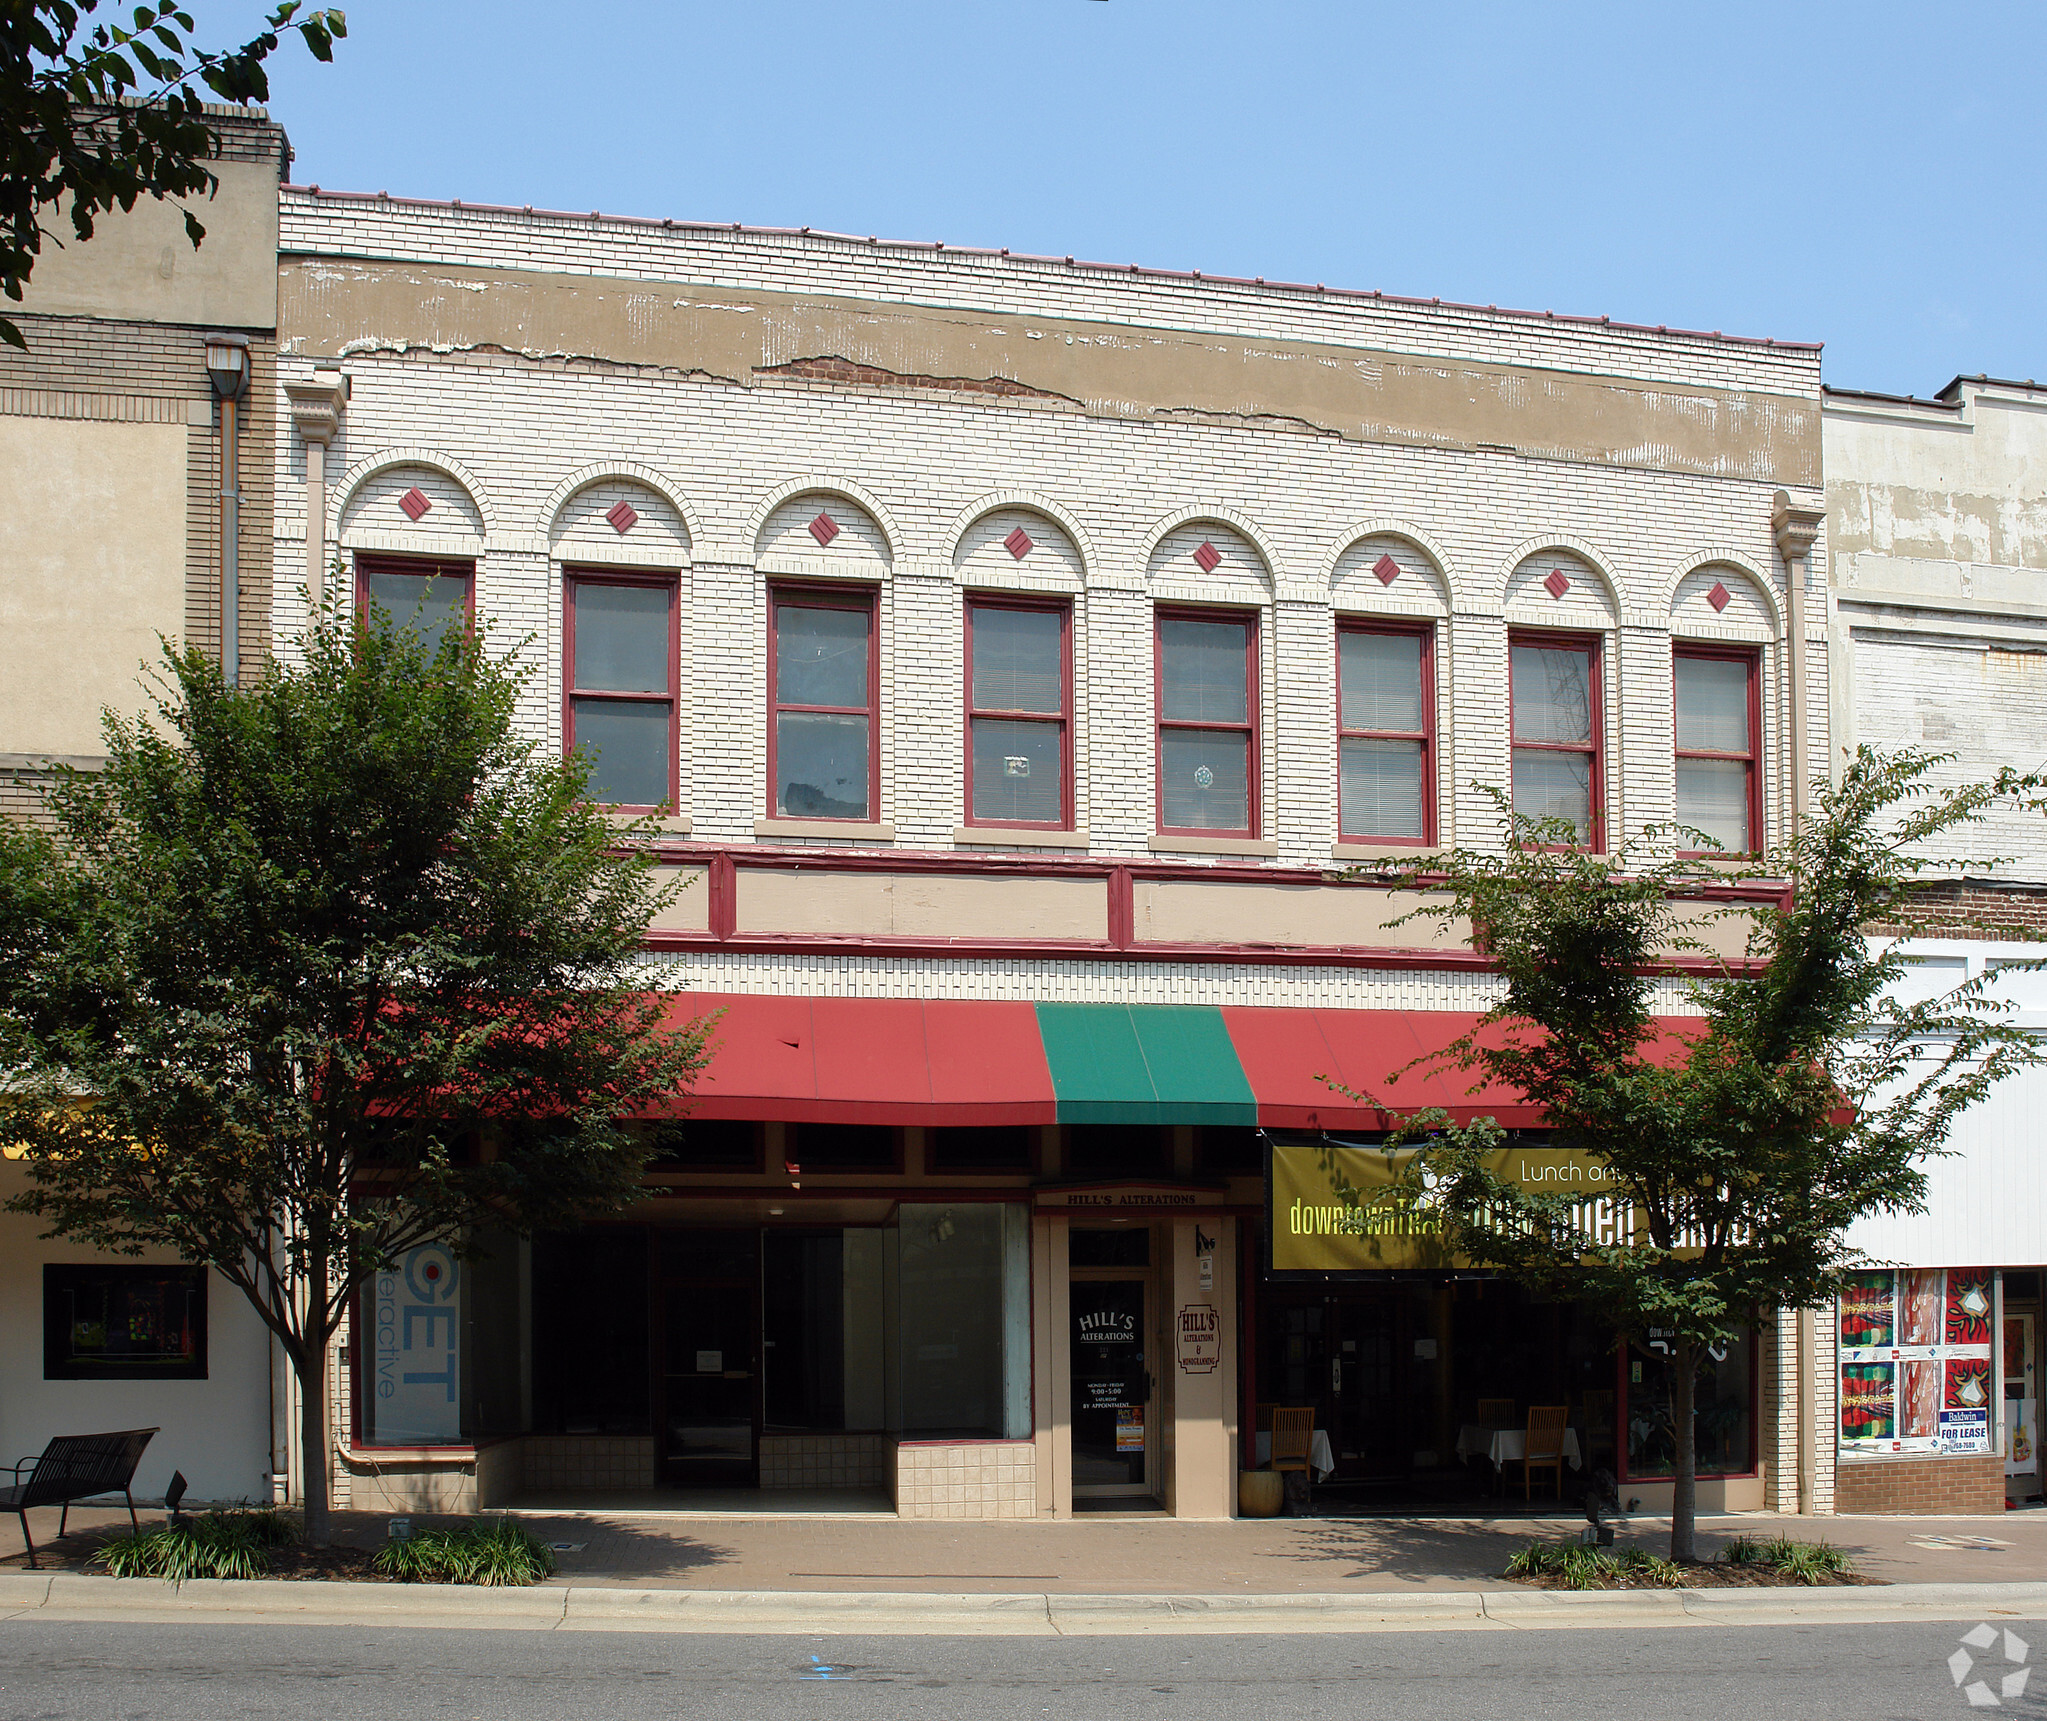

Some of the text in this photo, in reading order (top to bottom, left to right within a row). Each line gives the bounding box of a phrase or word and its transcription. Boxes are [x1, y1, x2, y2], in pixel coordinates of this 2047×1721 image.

[1521, 1160, 1582, 1182] Lunch
[1068, 1194, 1196, 1205] HILL'S ALTERATIONS
[404, 1241, 459, 1402] GET
[1079, 1311, 1135, 1331] HILL'S
[1182, 1313, 1215, 1332] HILL'S
[1080, 1332, 1134, 1341] ALTERATIONS
[1183, 1334, 1214, 1343] ALTERATIONS
[1196, 1345, 1201, 1355] &
[1182, 1357, 1215, 1366] MONOGRAMMING
[1949, 1411, 1977, 1421] Baldwin
[1941, 1428, 1986, 1439] FOR LEASE
